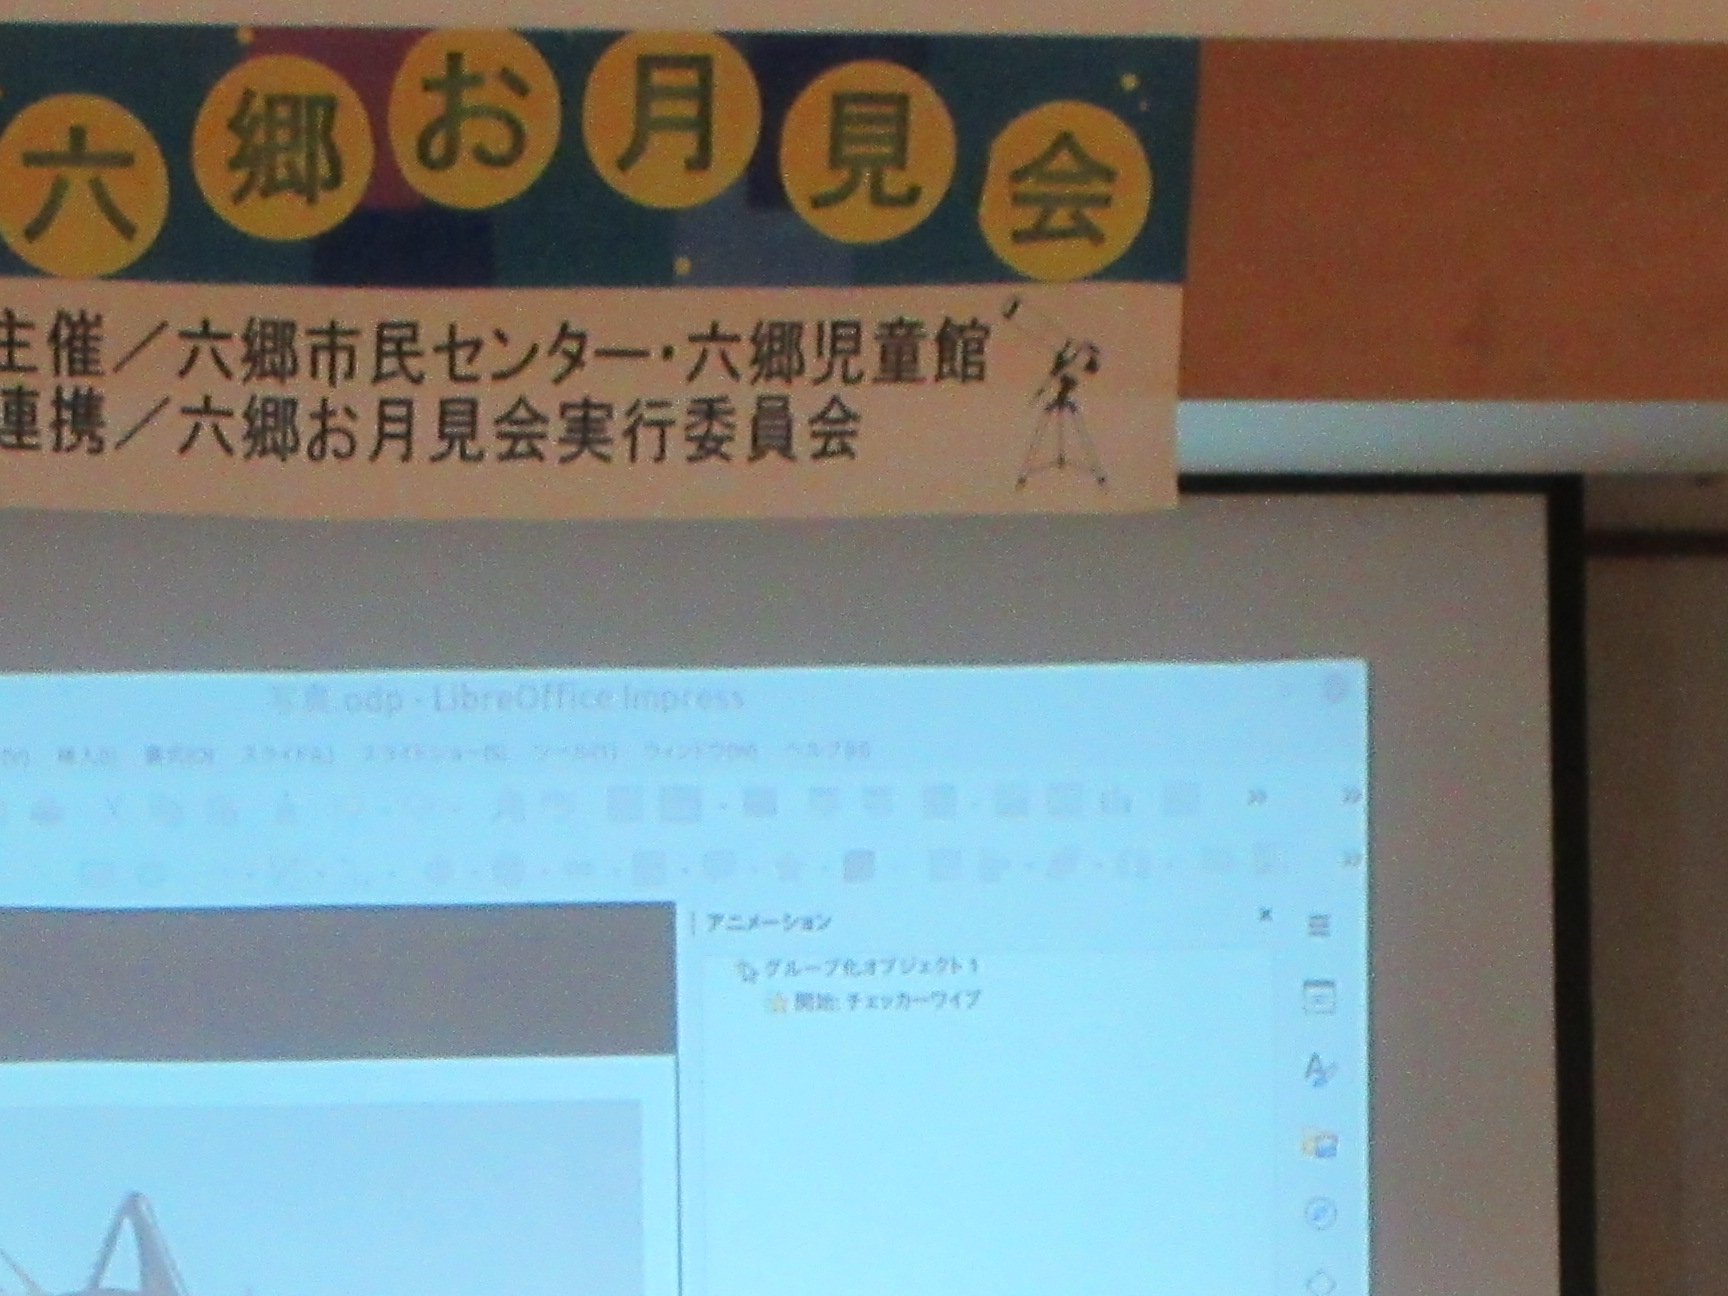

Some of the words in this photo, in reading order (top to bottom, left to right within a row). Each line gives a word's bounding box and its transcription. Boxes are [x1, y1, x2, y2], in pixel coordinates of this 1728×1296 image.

[20, 49, 1120, 249] 六郷お月見会
[622, 682, 745, 715] Impress
[706, 911, 833, 934] アニメーション
